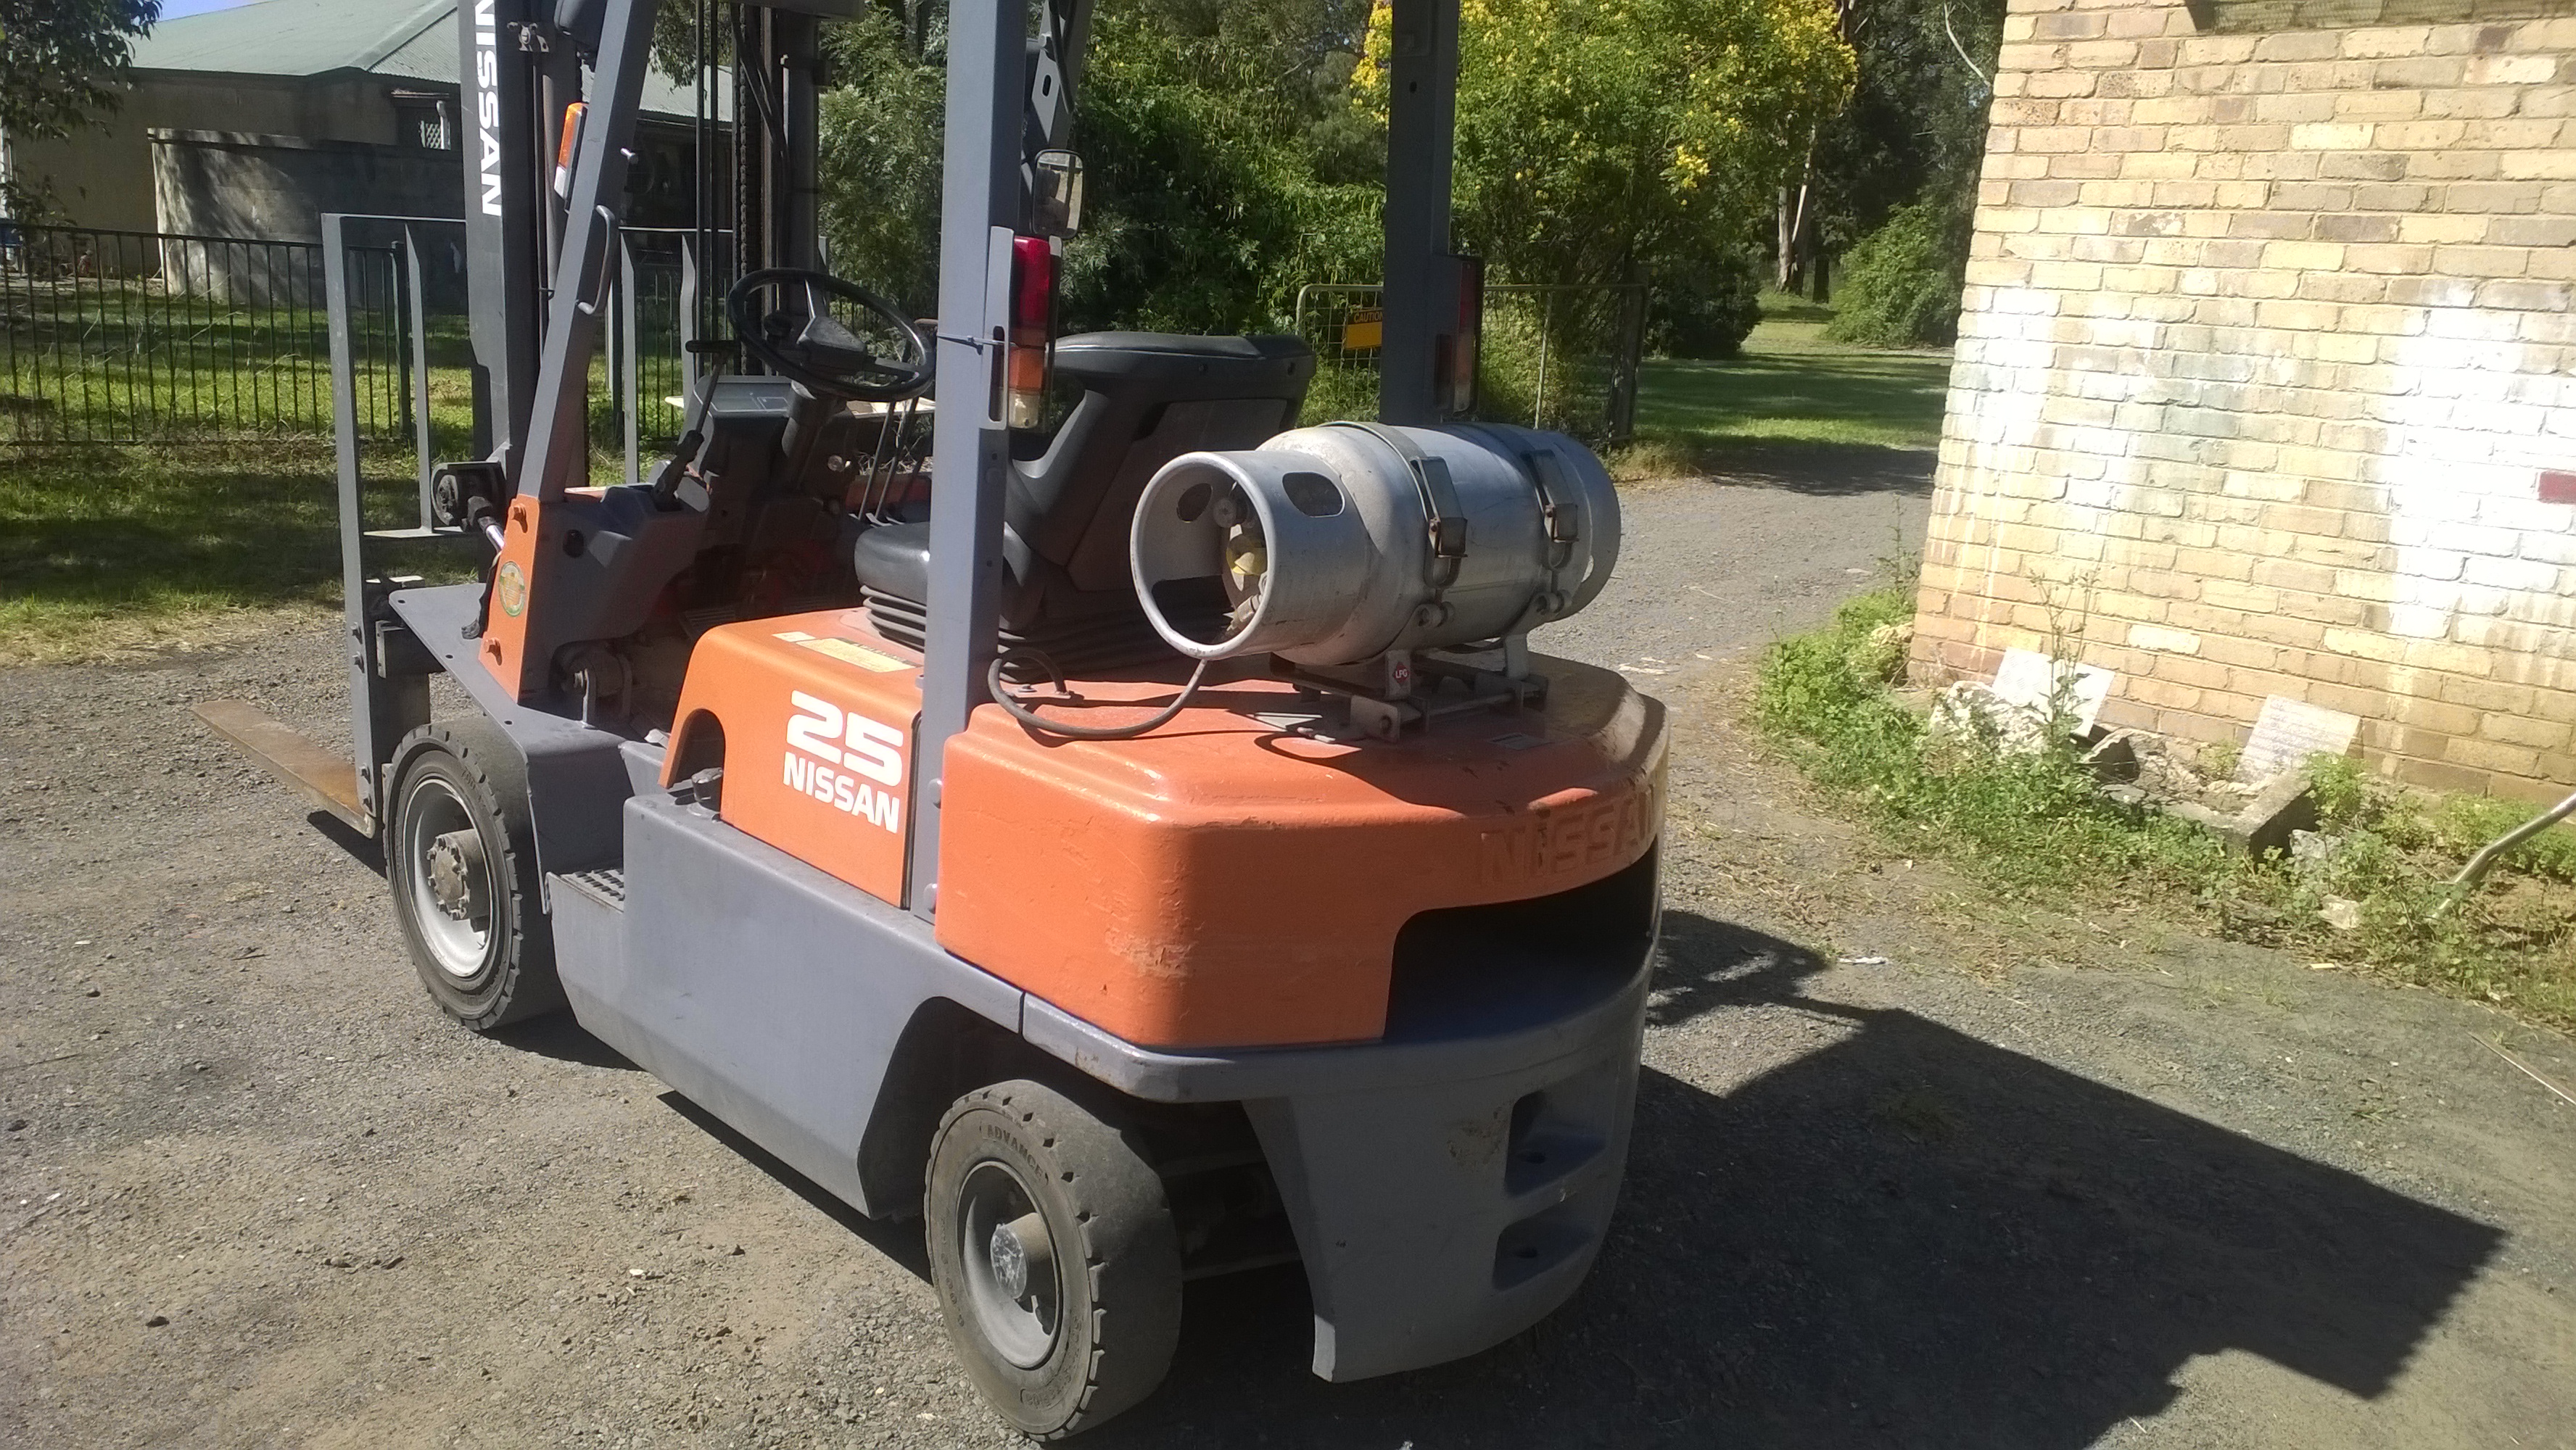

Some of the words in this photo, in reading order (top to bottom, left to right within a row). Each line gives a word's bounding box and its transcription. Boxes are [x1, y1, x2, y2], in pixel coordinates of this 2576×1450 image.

[475, 0, 503, 217] NISSAN
[1395, 668, 1408, 679] LPG
[786, 689, 904, 787] 25
[783, 751, 900, 833] NISSAN
[1480, 784, 1656, 884] NISSAN
[987, 1124, 1044, 1179] ADVANCE
